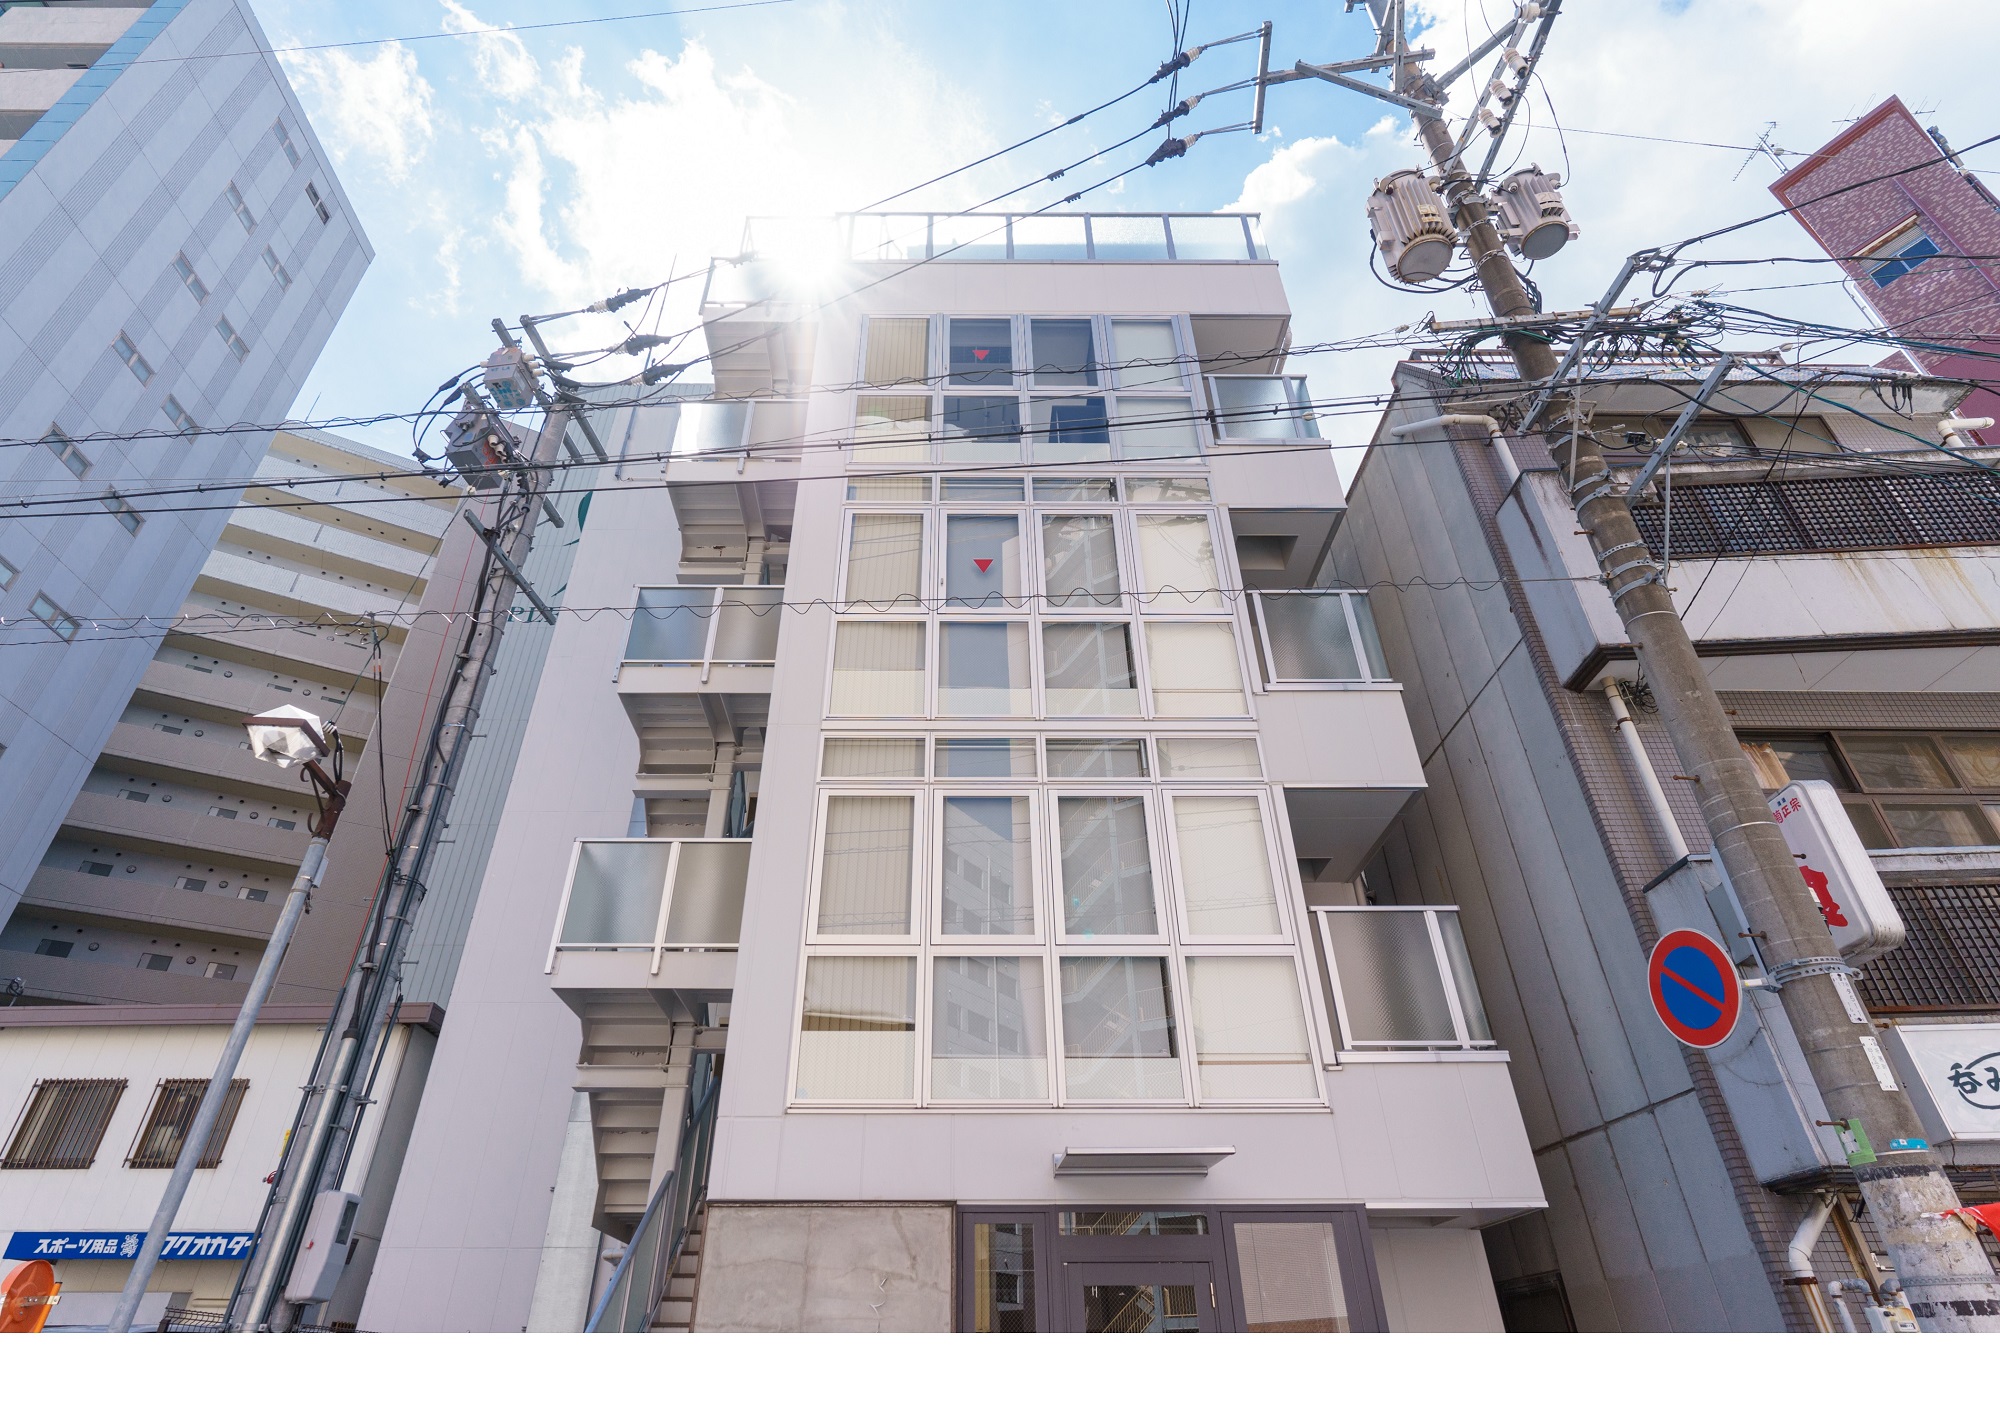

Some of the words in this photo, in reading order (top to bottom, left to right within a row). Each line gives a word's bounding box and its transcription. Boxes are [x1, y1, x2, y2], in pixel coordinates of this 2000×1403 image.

[33, 1237, 118, 1254] スポーツ用品
[160, 1235, 262, 1255] フクオカタ
